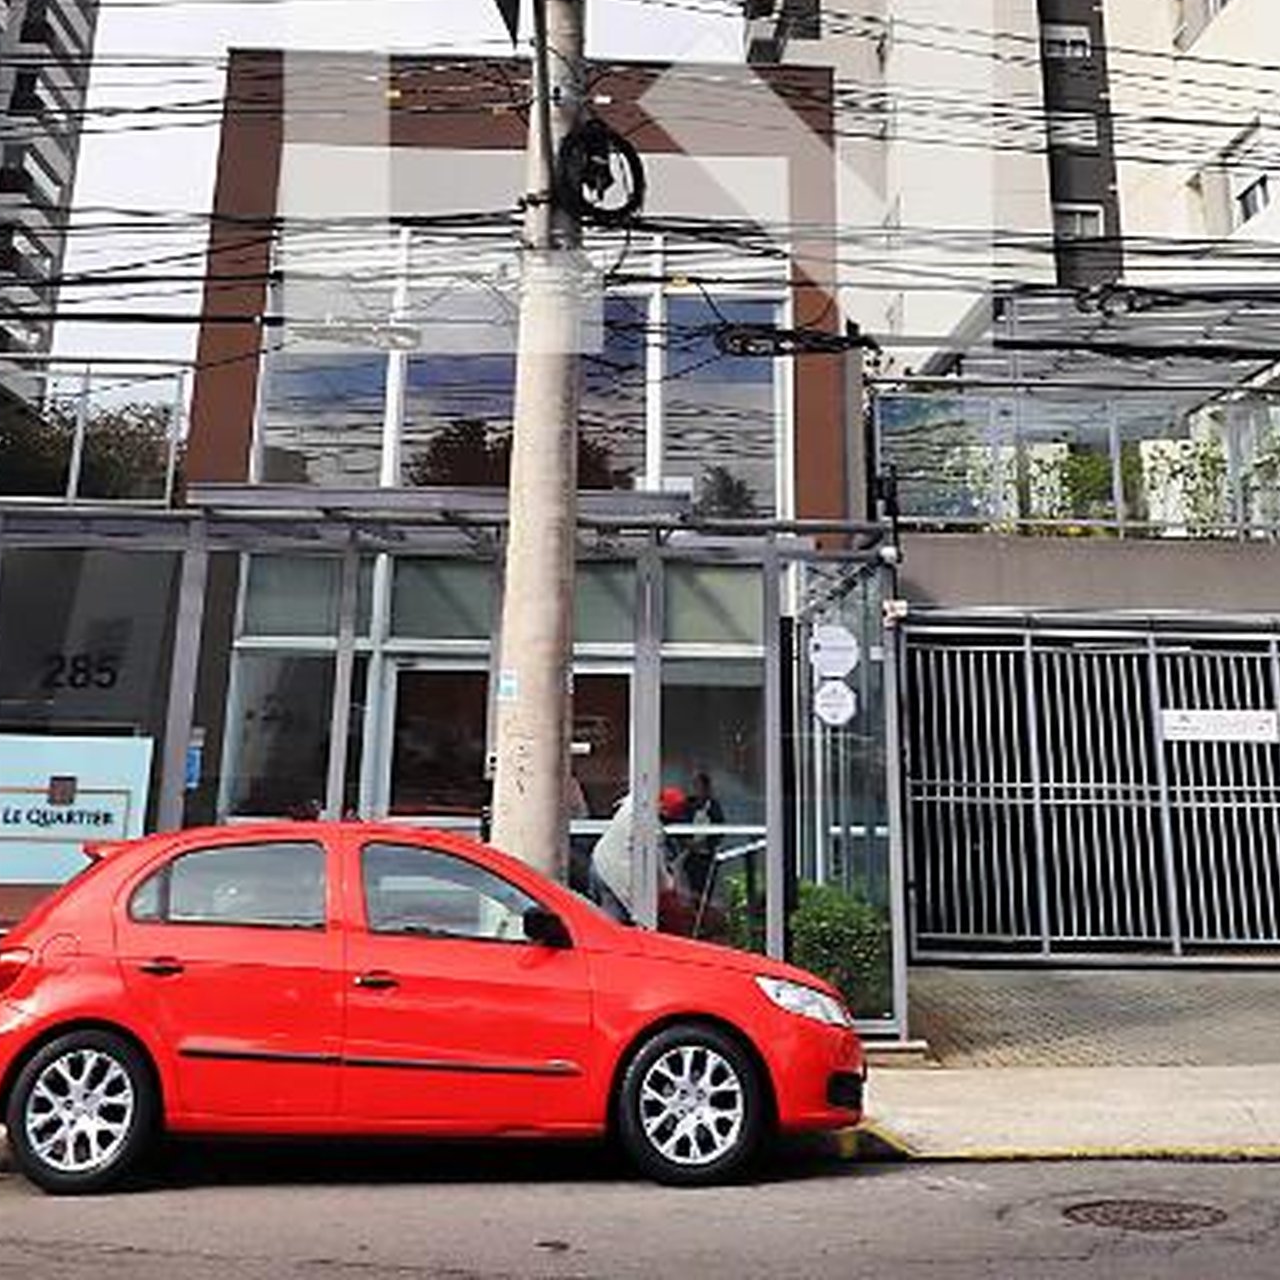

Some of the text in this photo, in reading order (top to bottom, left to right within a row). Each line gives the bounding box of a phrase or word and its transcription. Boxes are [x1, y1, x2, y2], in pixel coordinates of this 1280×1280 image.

[42, 653, 118, 689] 285
[1, 807, 115, 827] LE QUARTIER
